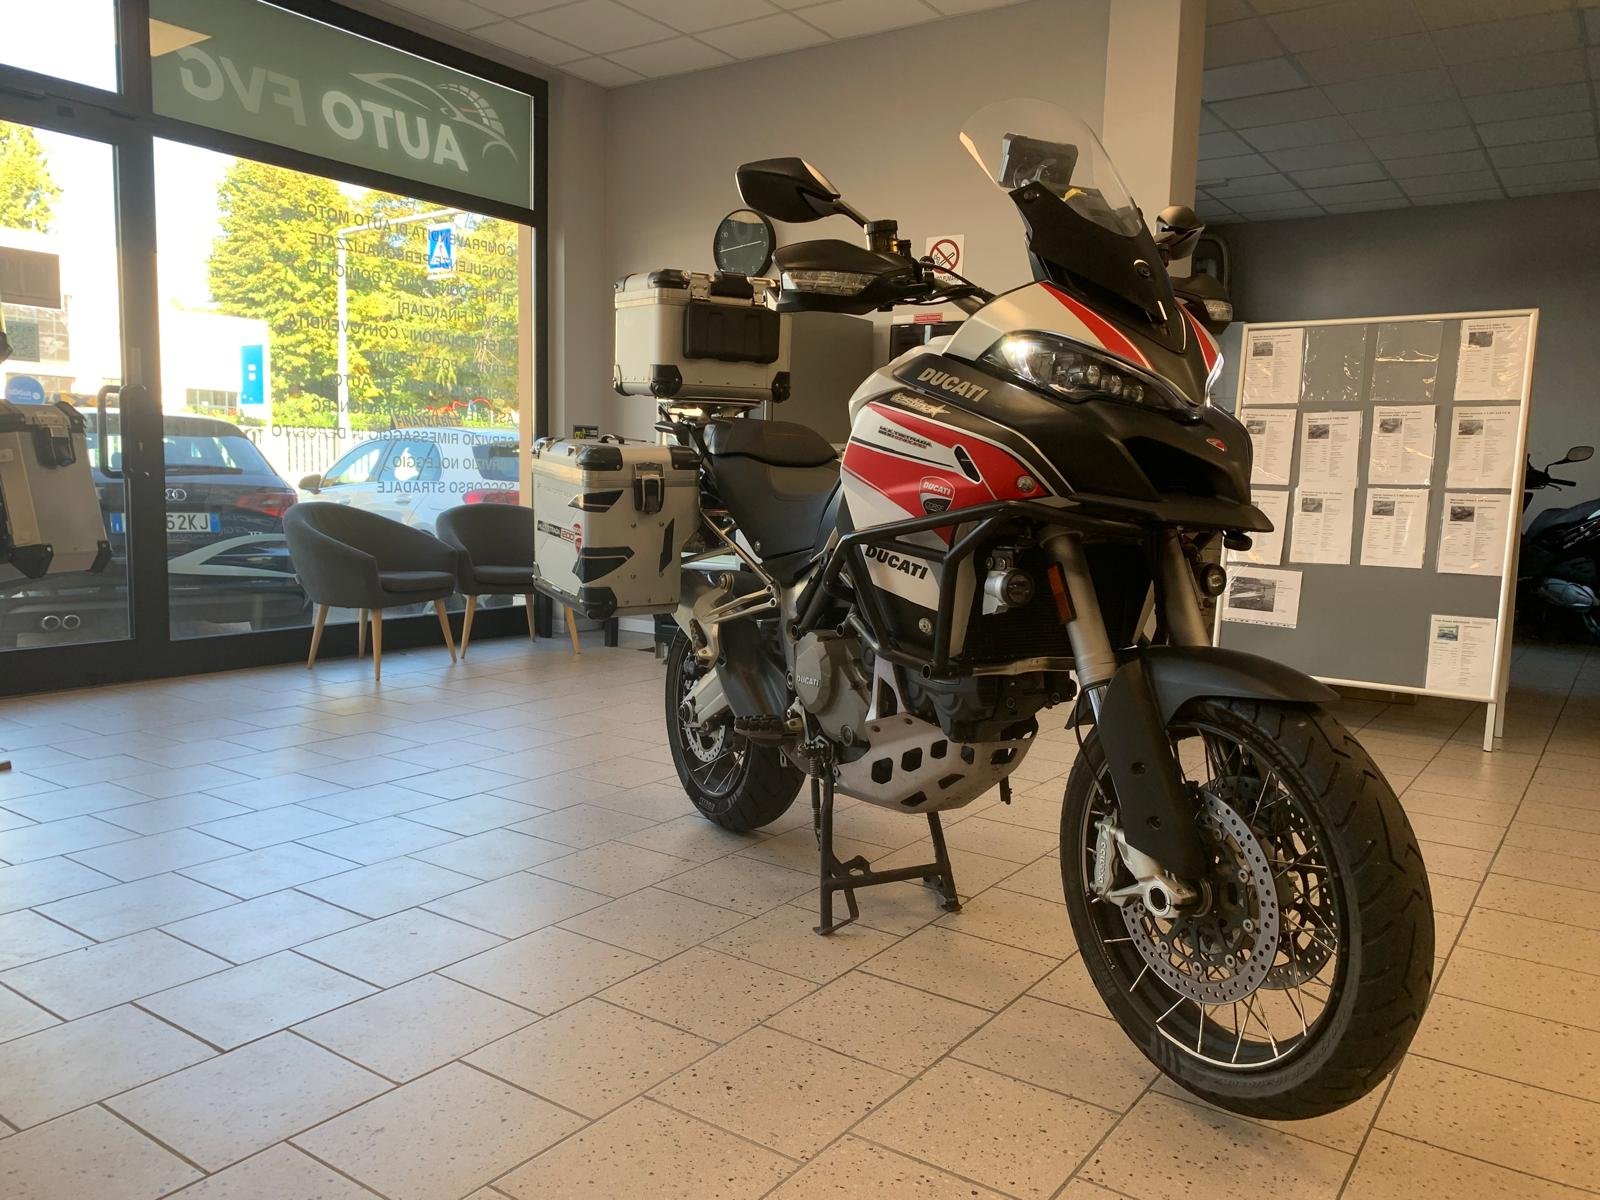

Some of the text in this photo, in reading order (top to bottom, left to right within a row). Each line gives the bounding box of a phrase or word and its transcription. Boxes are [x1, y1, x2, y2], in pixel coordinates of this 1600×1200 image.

[917, 367, 989, 404] DUCATI
[922, 481, 951, 495] DUCATI
[865, 544, 929, 581] DUCATI
[796, 674, 821, 688] DUCATI
